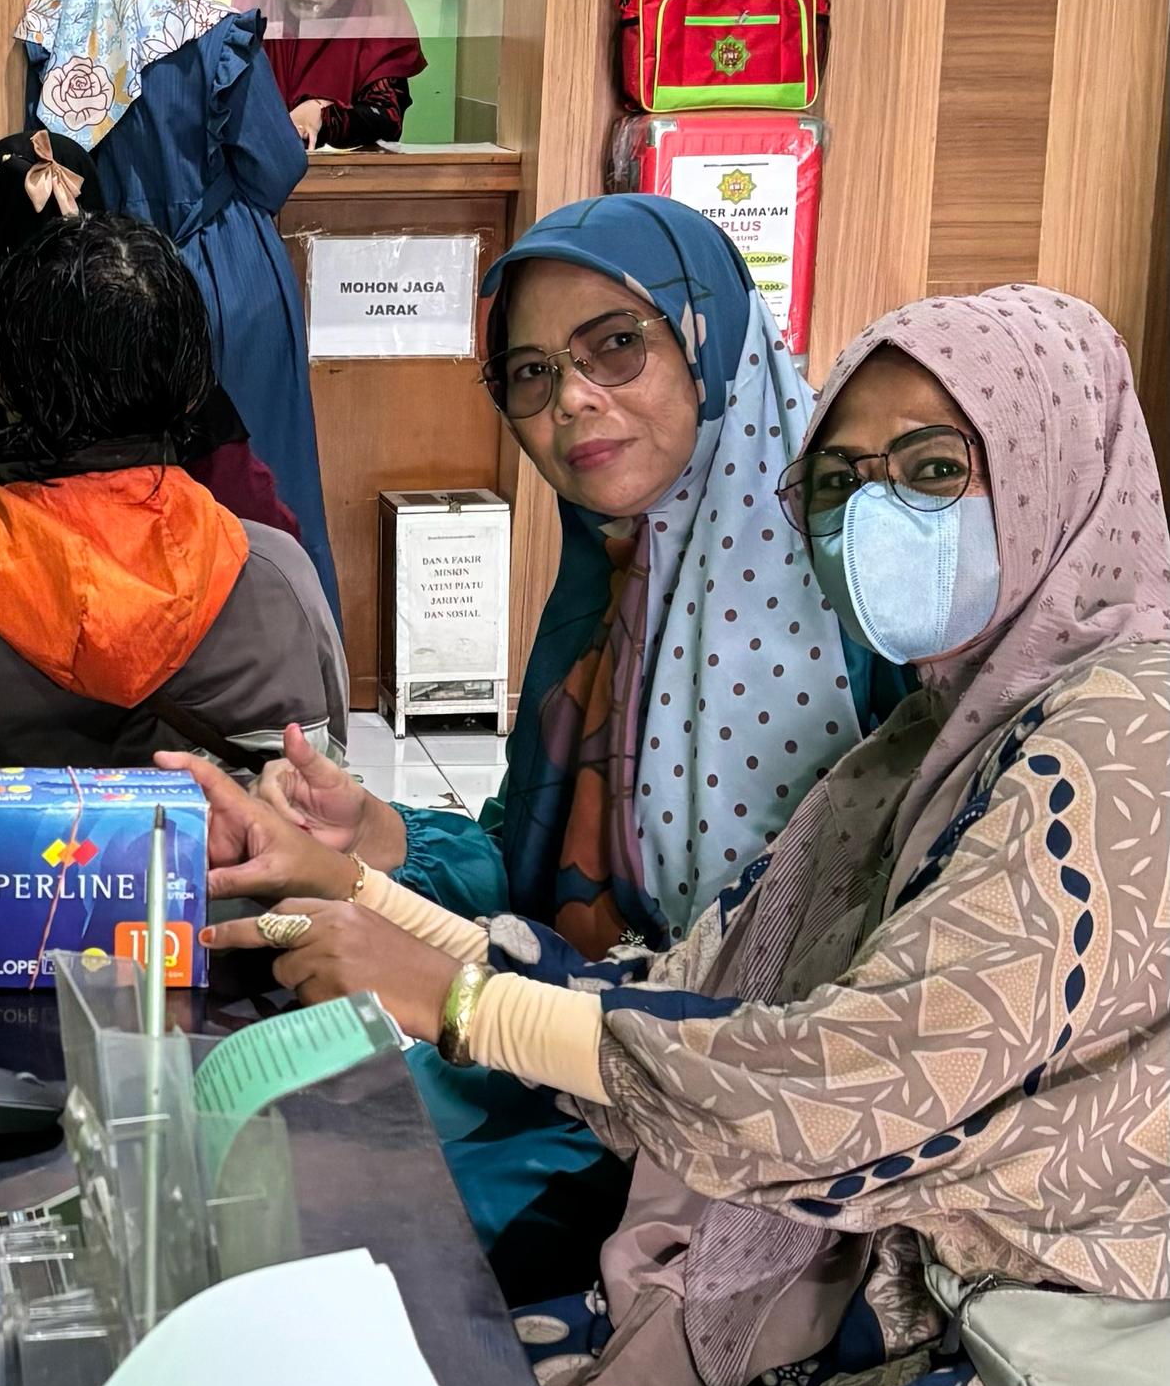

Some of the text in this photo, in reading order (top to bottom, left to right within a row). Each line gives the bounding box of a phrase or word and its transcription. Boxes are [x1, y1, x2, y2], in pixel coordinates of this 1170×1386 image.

[731, 207, 788, 217] JAMA'AH
[721, 221, 761, 232] PLUS
[340, 281, 445, 293] MOHON JAGA
[365, 304, 418, 315] JARAK
[422, 555, 481, 565] DANA FAKIR
[433, 568, 470, 577] MISKIN
[420, 581, 484, 591] YATIM PIATU
[430, 596, 473, 605] JARIYAH
[424, 609, 481, 619] DAN SOSIAL
